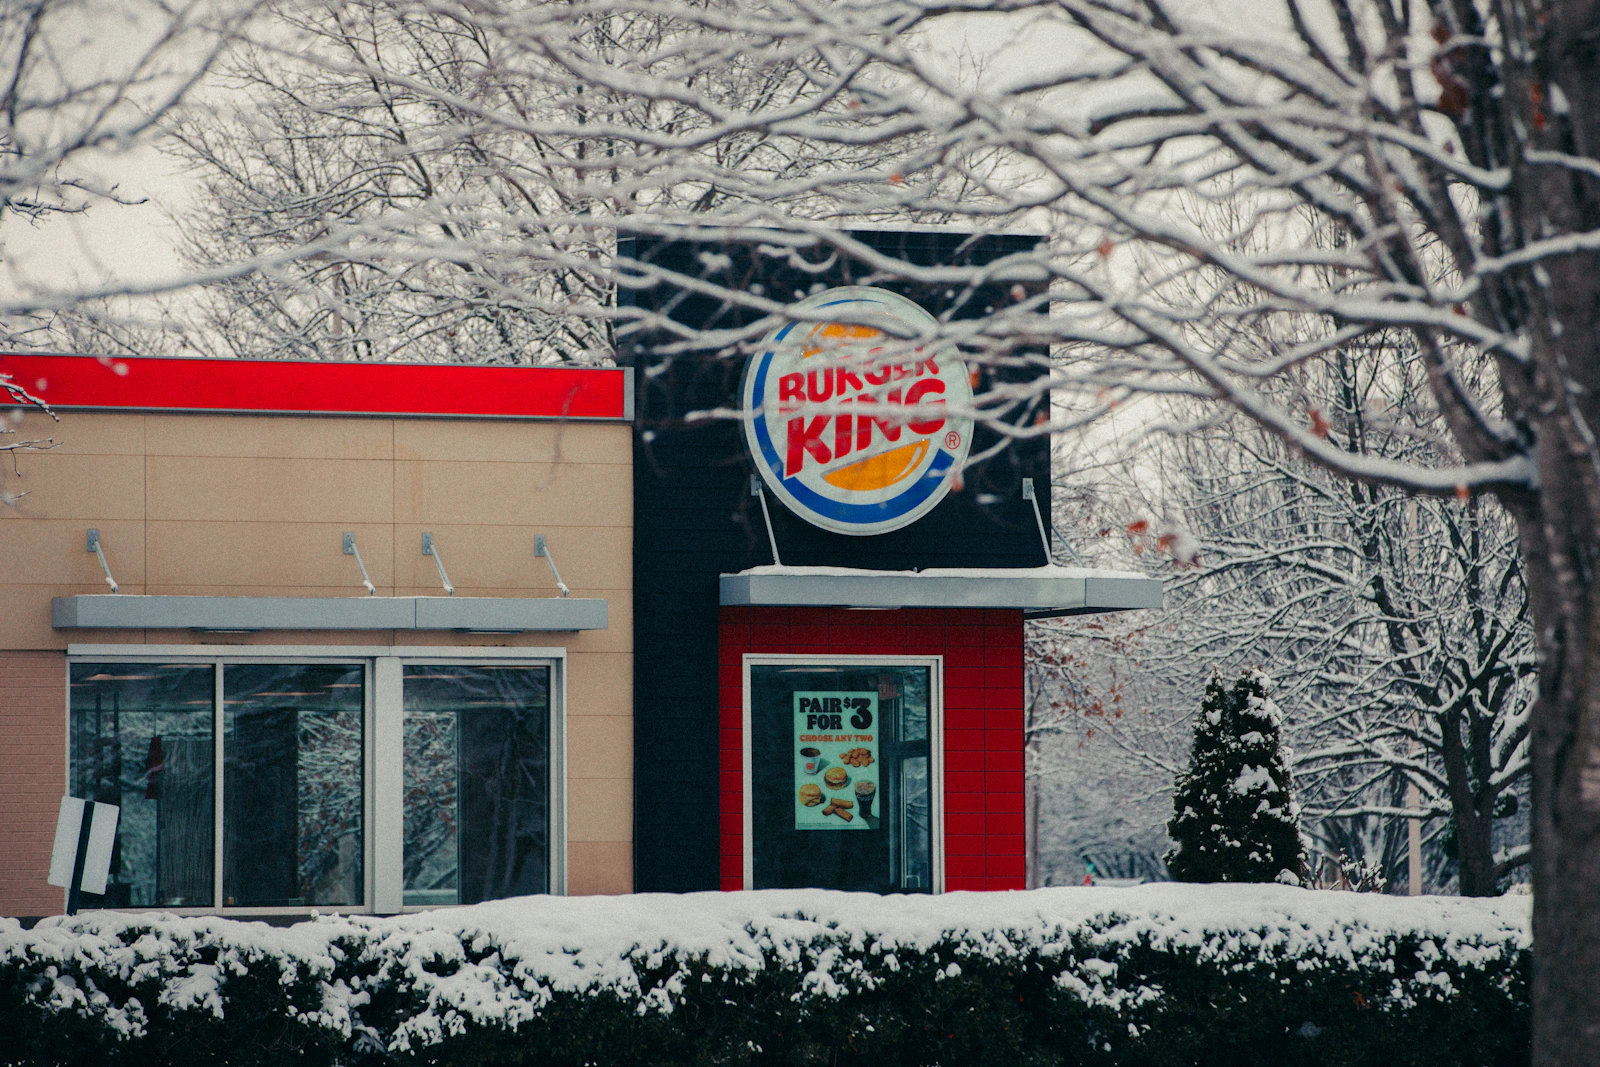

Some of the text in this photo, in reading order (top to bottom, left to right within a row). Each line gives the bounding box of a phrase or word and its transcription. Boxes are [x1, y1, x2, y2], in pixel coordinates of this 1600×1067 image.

[785, 378, 946, 477] KING
[799, 697, 843, 713] PAIR
[807, 714, 843, 730] FOR
[799, 734, 873, 742] CHOOSE ANY TWO
